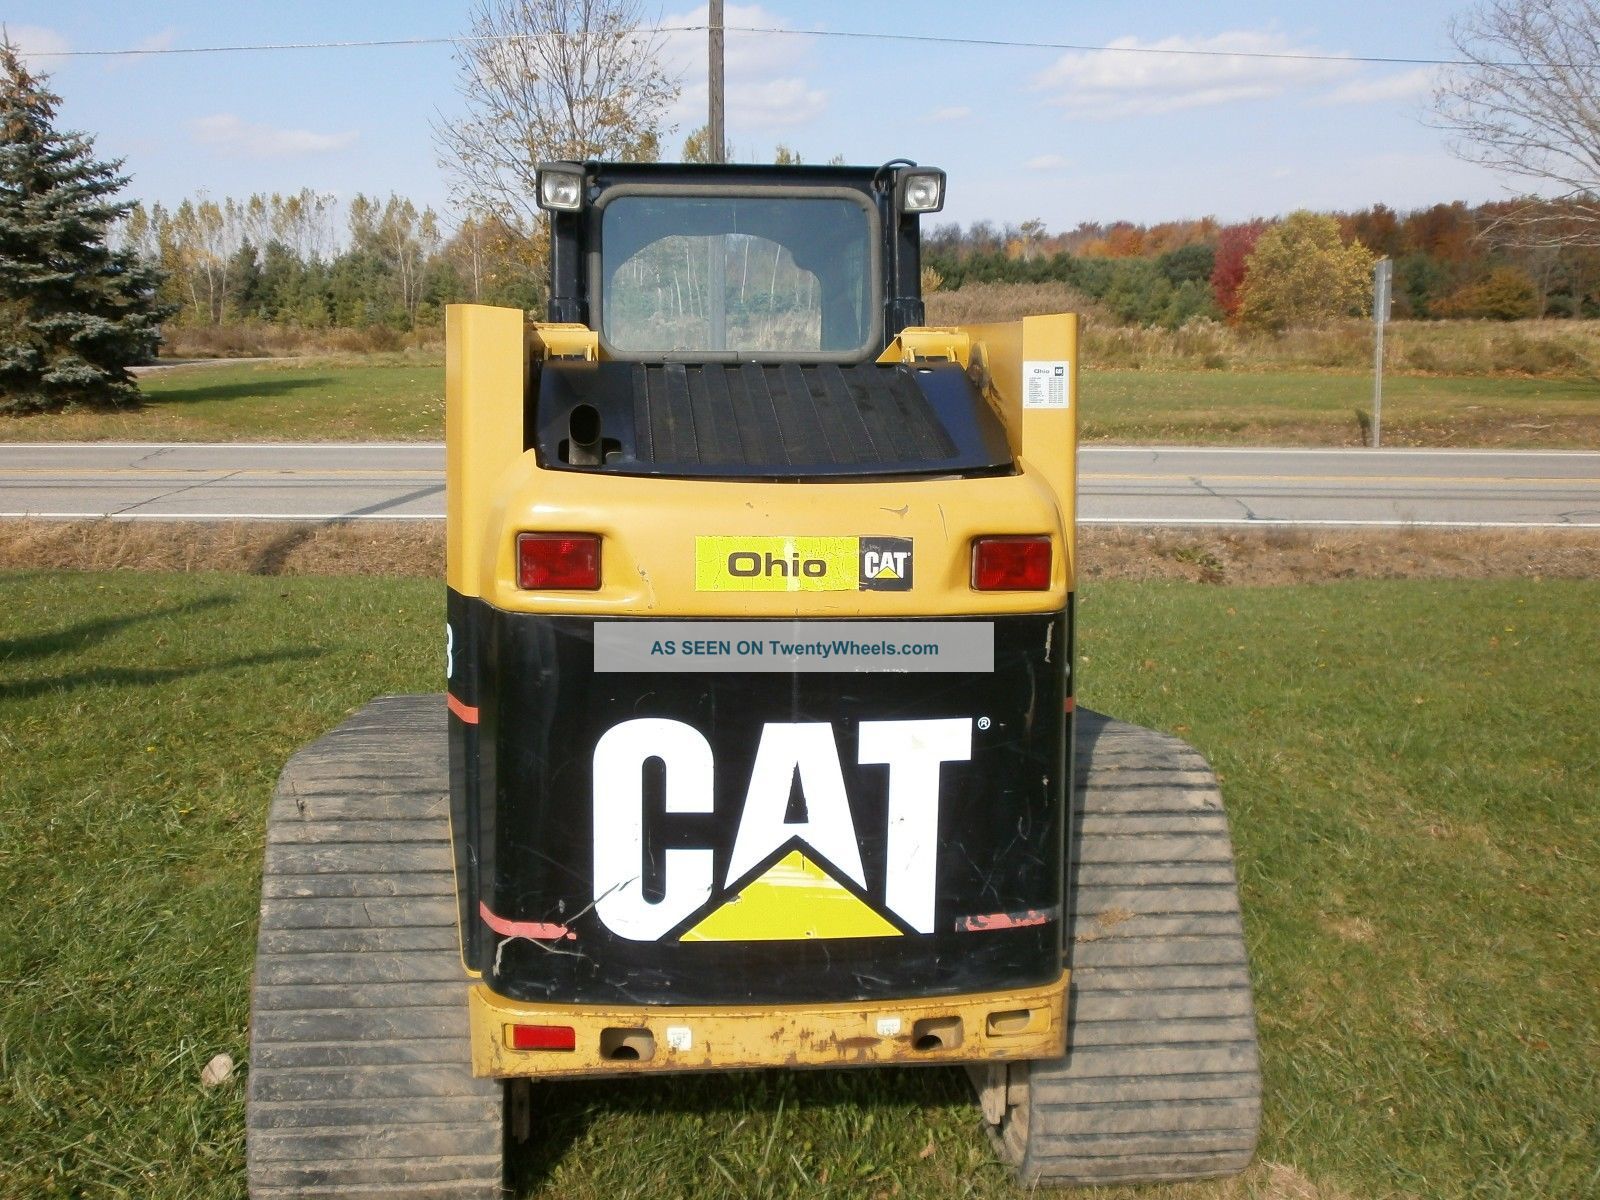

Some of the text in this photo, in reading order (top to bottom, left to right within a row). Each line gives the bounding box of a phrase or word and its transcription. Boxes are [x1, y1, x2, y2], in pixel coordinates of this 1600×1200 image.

[727, 551, 827, 578] Ohio
[864, 551, 908, 579] CAT
[592, 717, 973, 942] CAT
